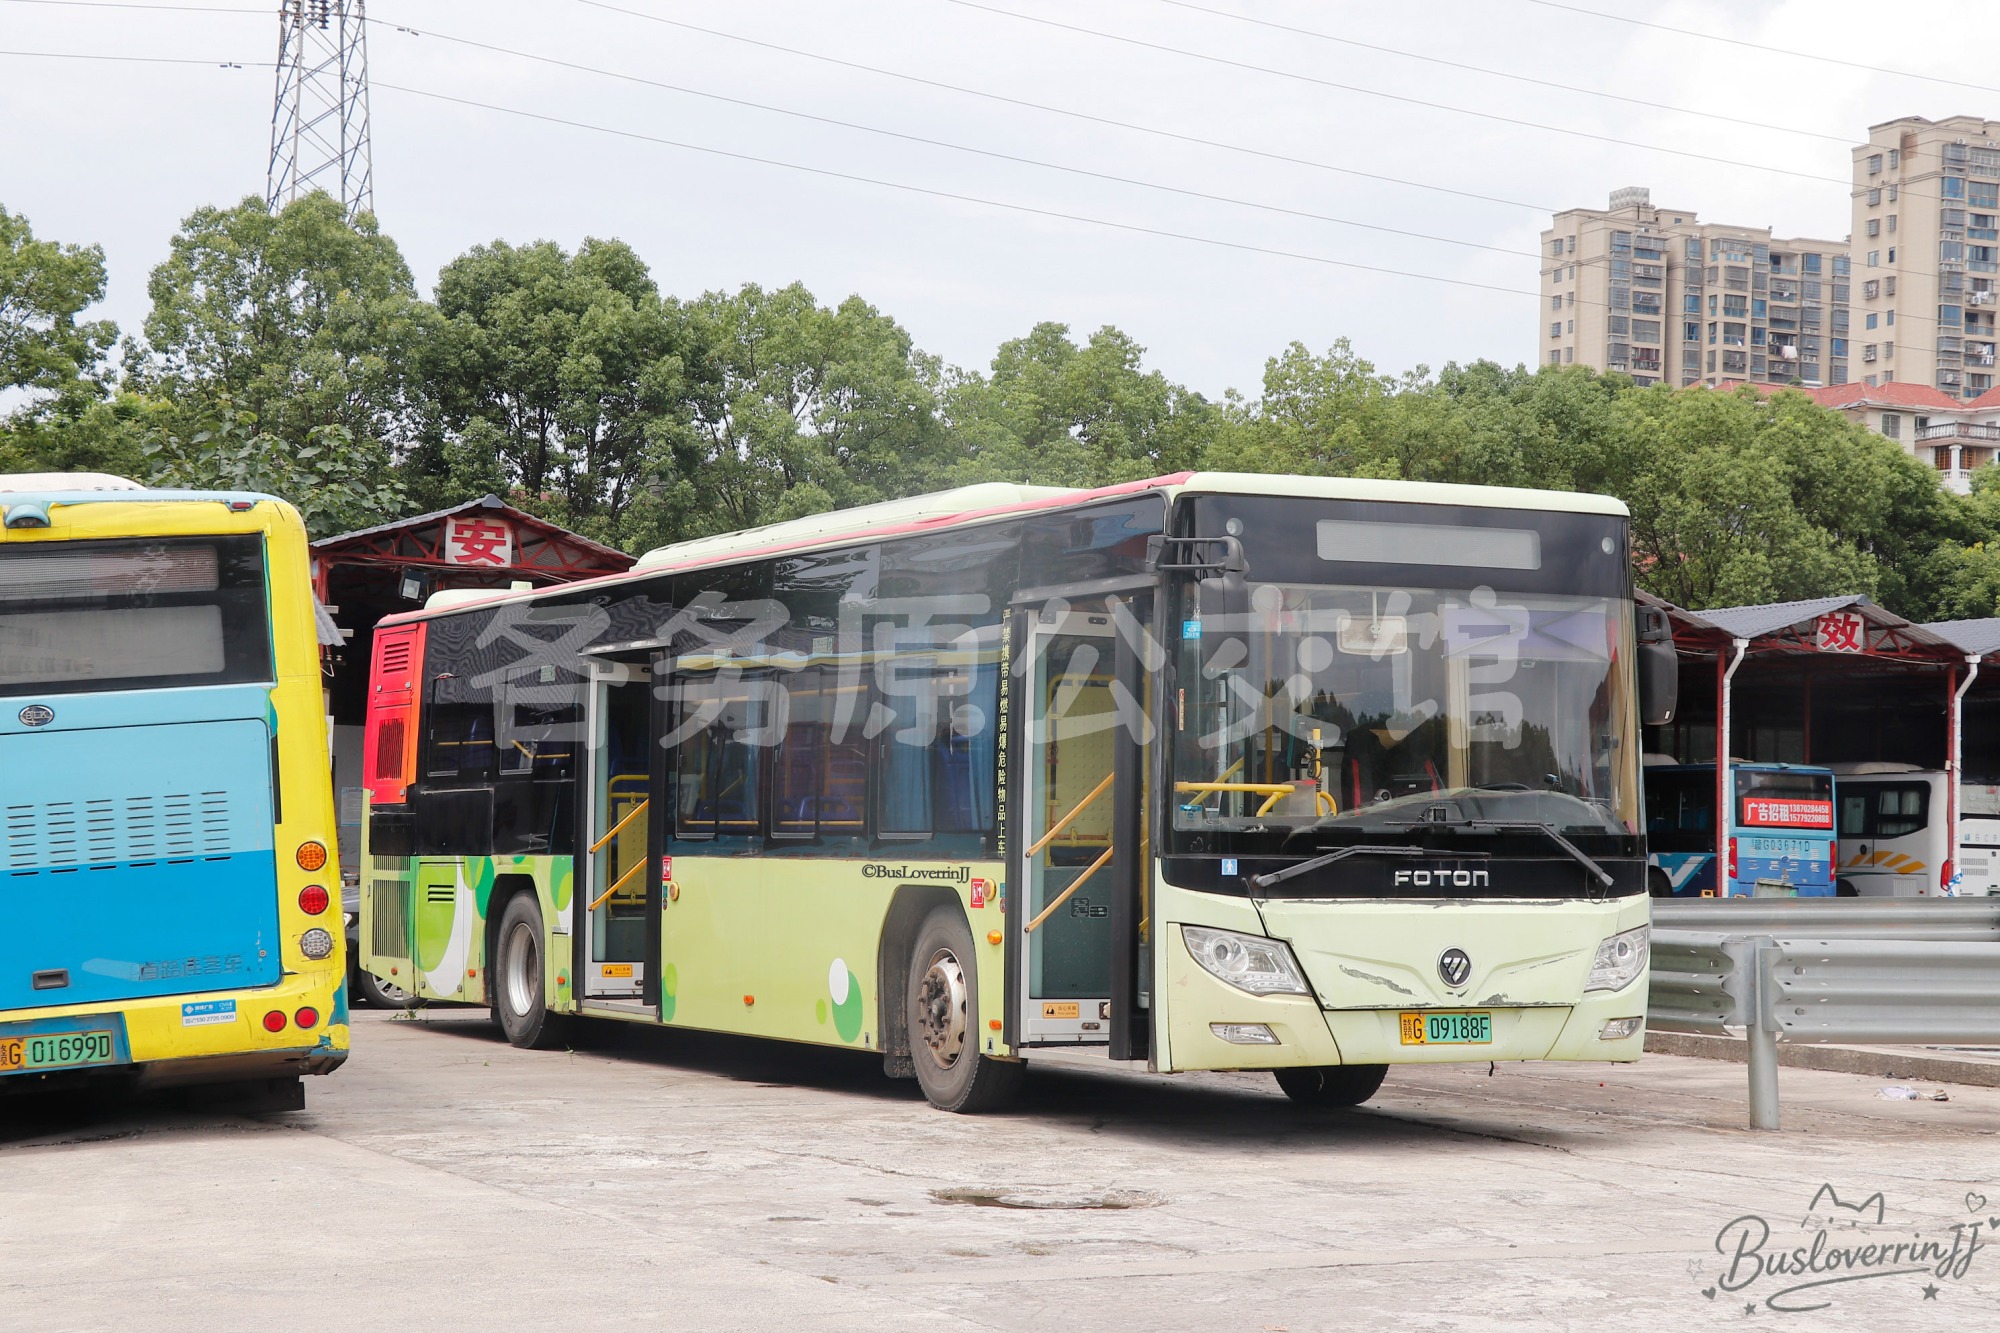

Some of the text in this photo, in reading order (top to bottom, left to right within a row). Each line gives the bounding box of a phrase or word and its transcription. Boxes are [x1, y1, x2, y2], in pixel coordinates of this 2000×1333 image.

[452, 520, 506, 565] 安
[1820, 613, 1860, 651] 效
[998, 608, 1012, 857] 严禁携带易燃易爆危险物品上车
[1747, 802, 1790, 822] 广告招租
[1395, 870, 1489, 886] FOTON
